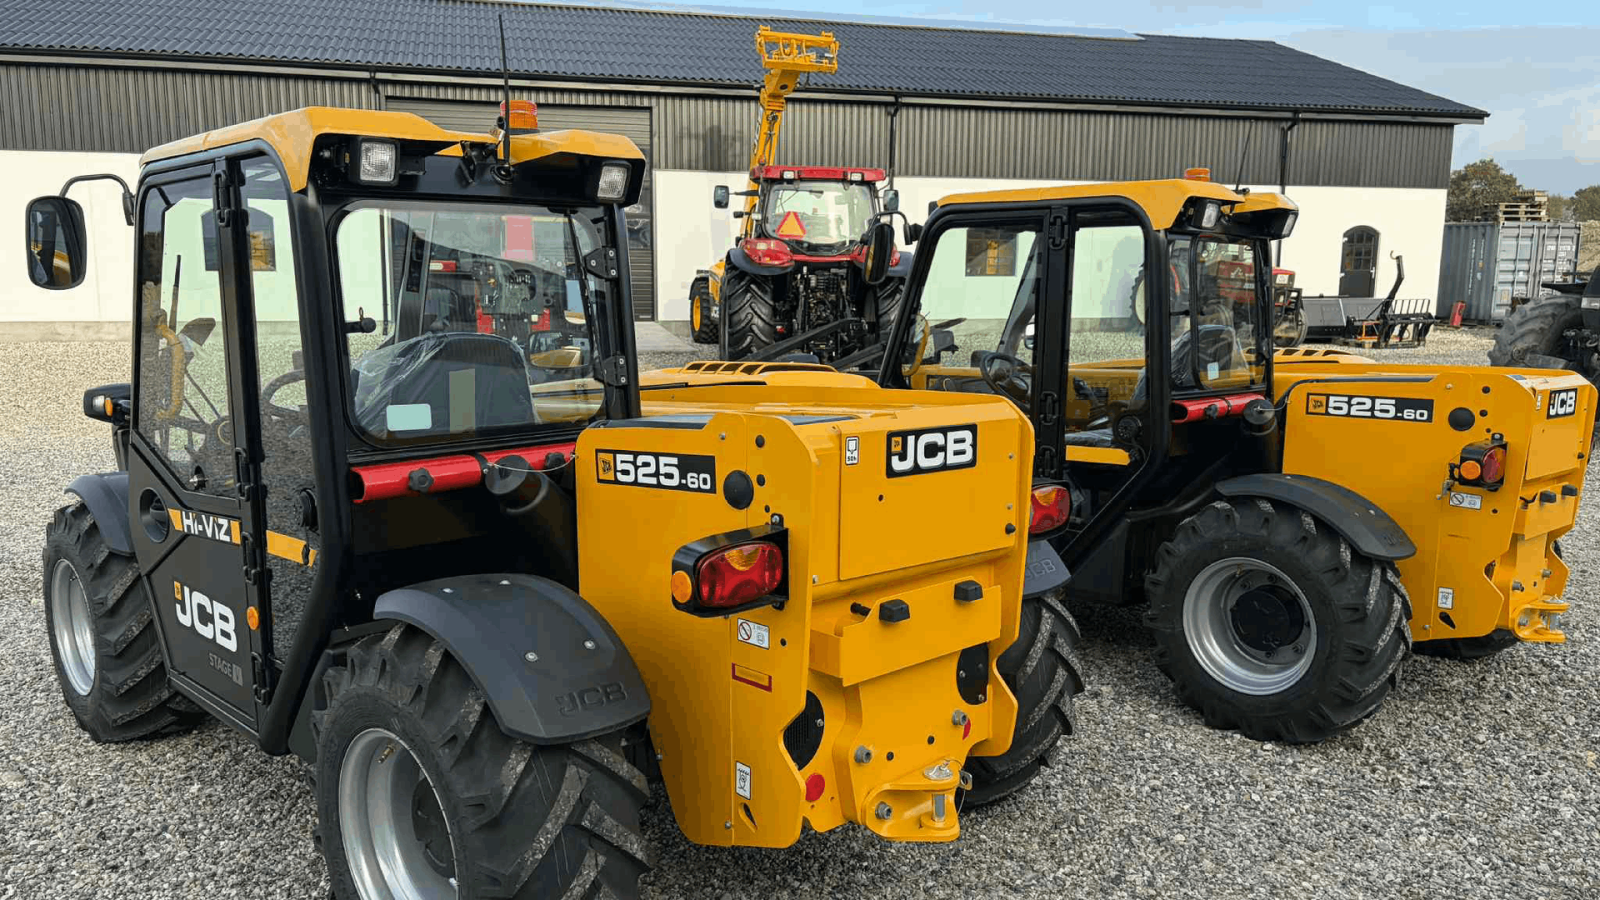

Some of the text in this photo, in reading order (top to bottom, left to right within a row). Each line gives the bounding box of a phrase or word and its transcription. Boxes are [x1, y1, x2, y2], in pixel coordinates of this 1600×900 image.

[1327, 395, 1429, 420] 525-60
[1550, 391, 1576, 416] JCB
[891, 430, 973, 473] JCB
[615, 453, 711, 488] 525-60
[175, 585, 238, 653] JCB
[208, 652, 232, 677] STAGE
[556, 681, 628, 717] JCB
